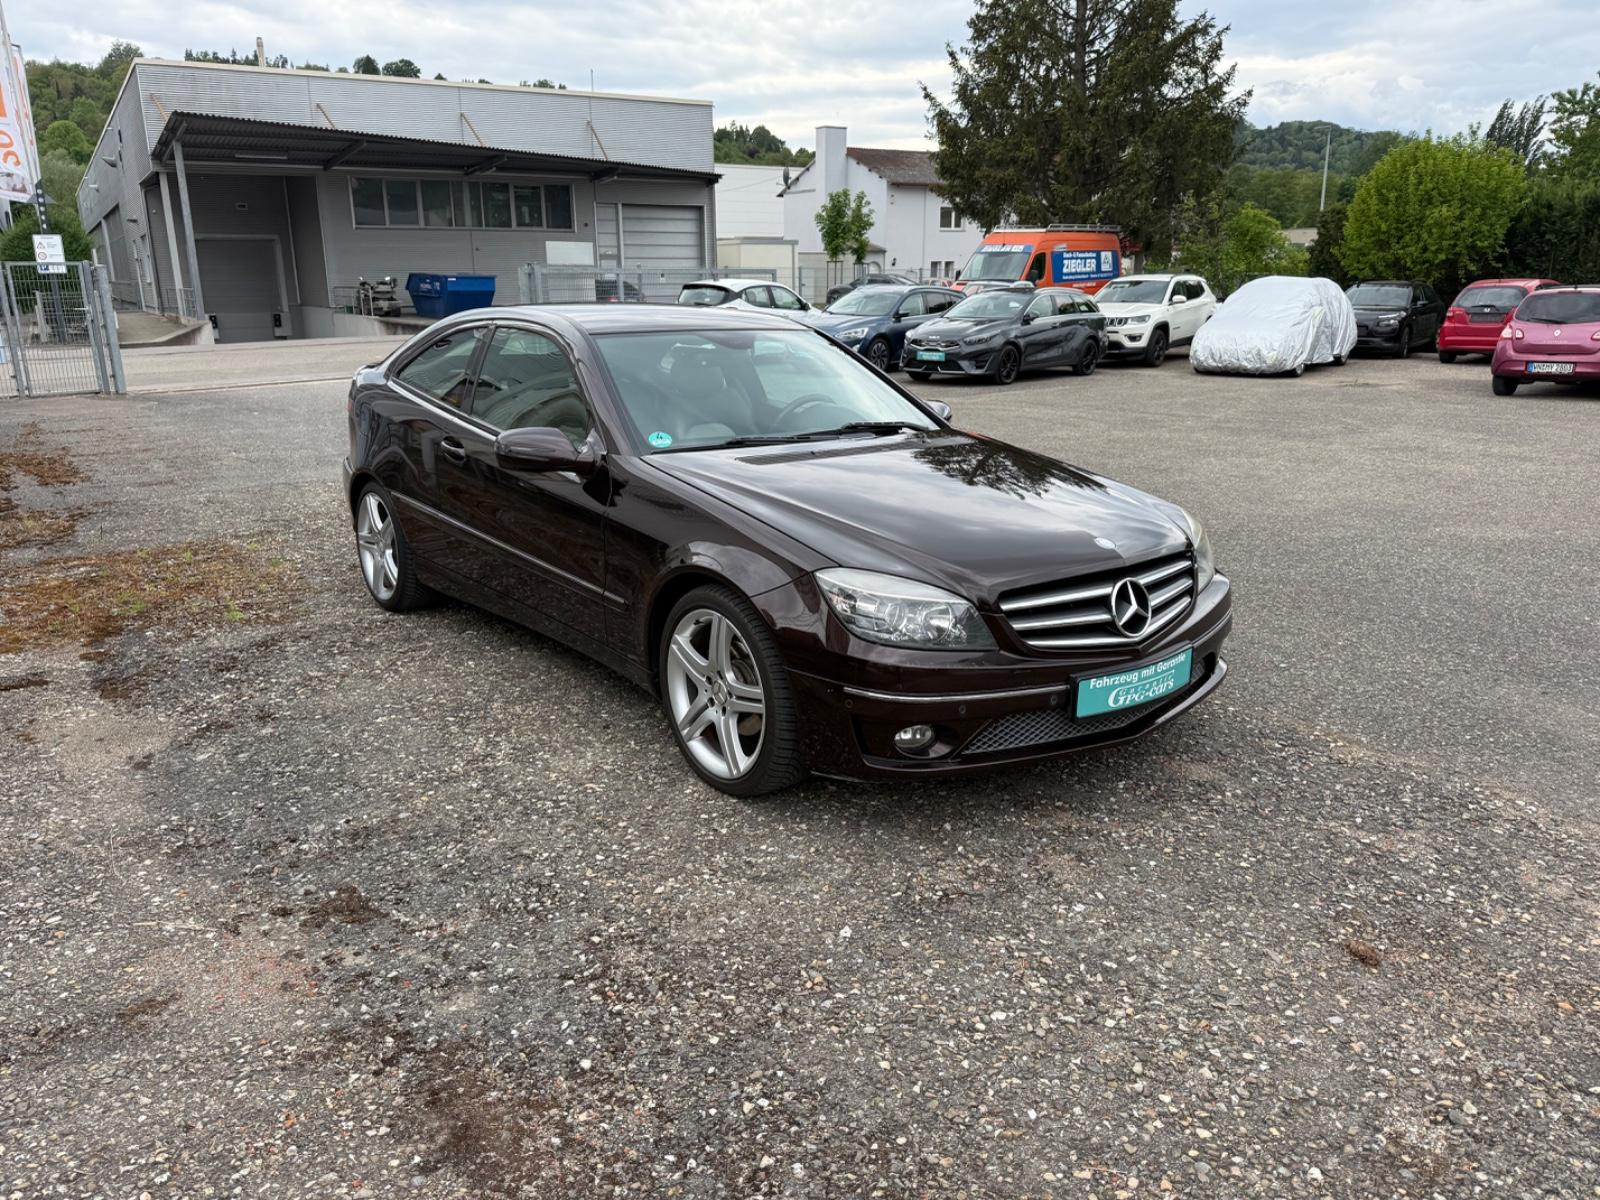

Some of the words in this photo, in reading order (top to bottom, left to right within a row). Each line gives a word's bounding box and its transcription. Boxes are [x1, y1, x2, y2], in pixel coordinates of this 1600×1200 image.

[1062, 259, 1097, 273] ZIEGLER
[1090, 671, 1139, 689] Fahrzeug
[1141, 664, 1156, 678] mit
[1157, 652, 1186, 672] Garantie
